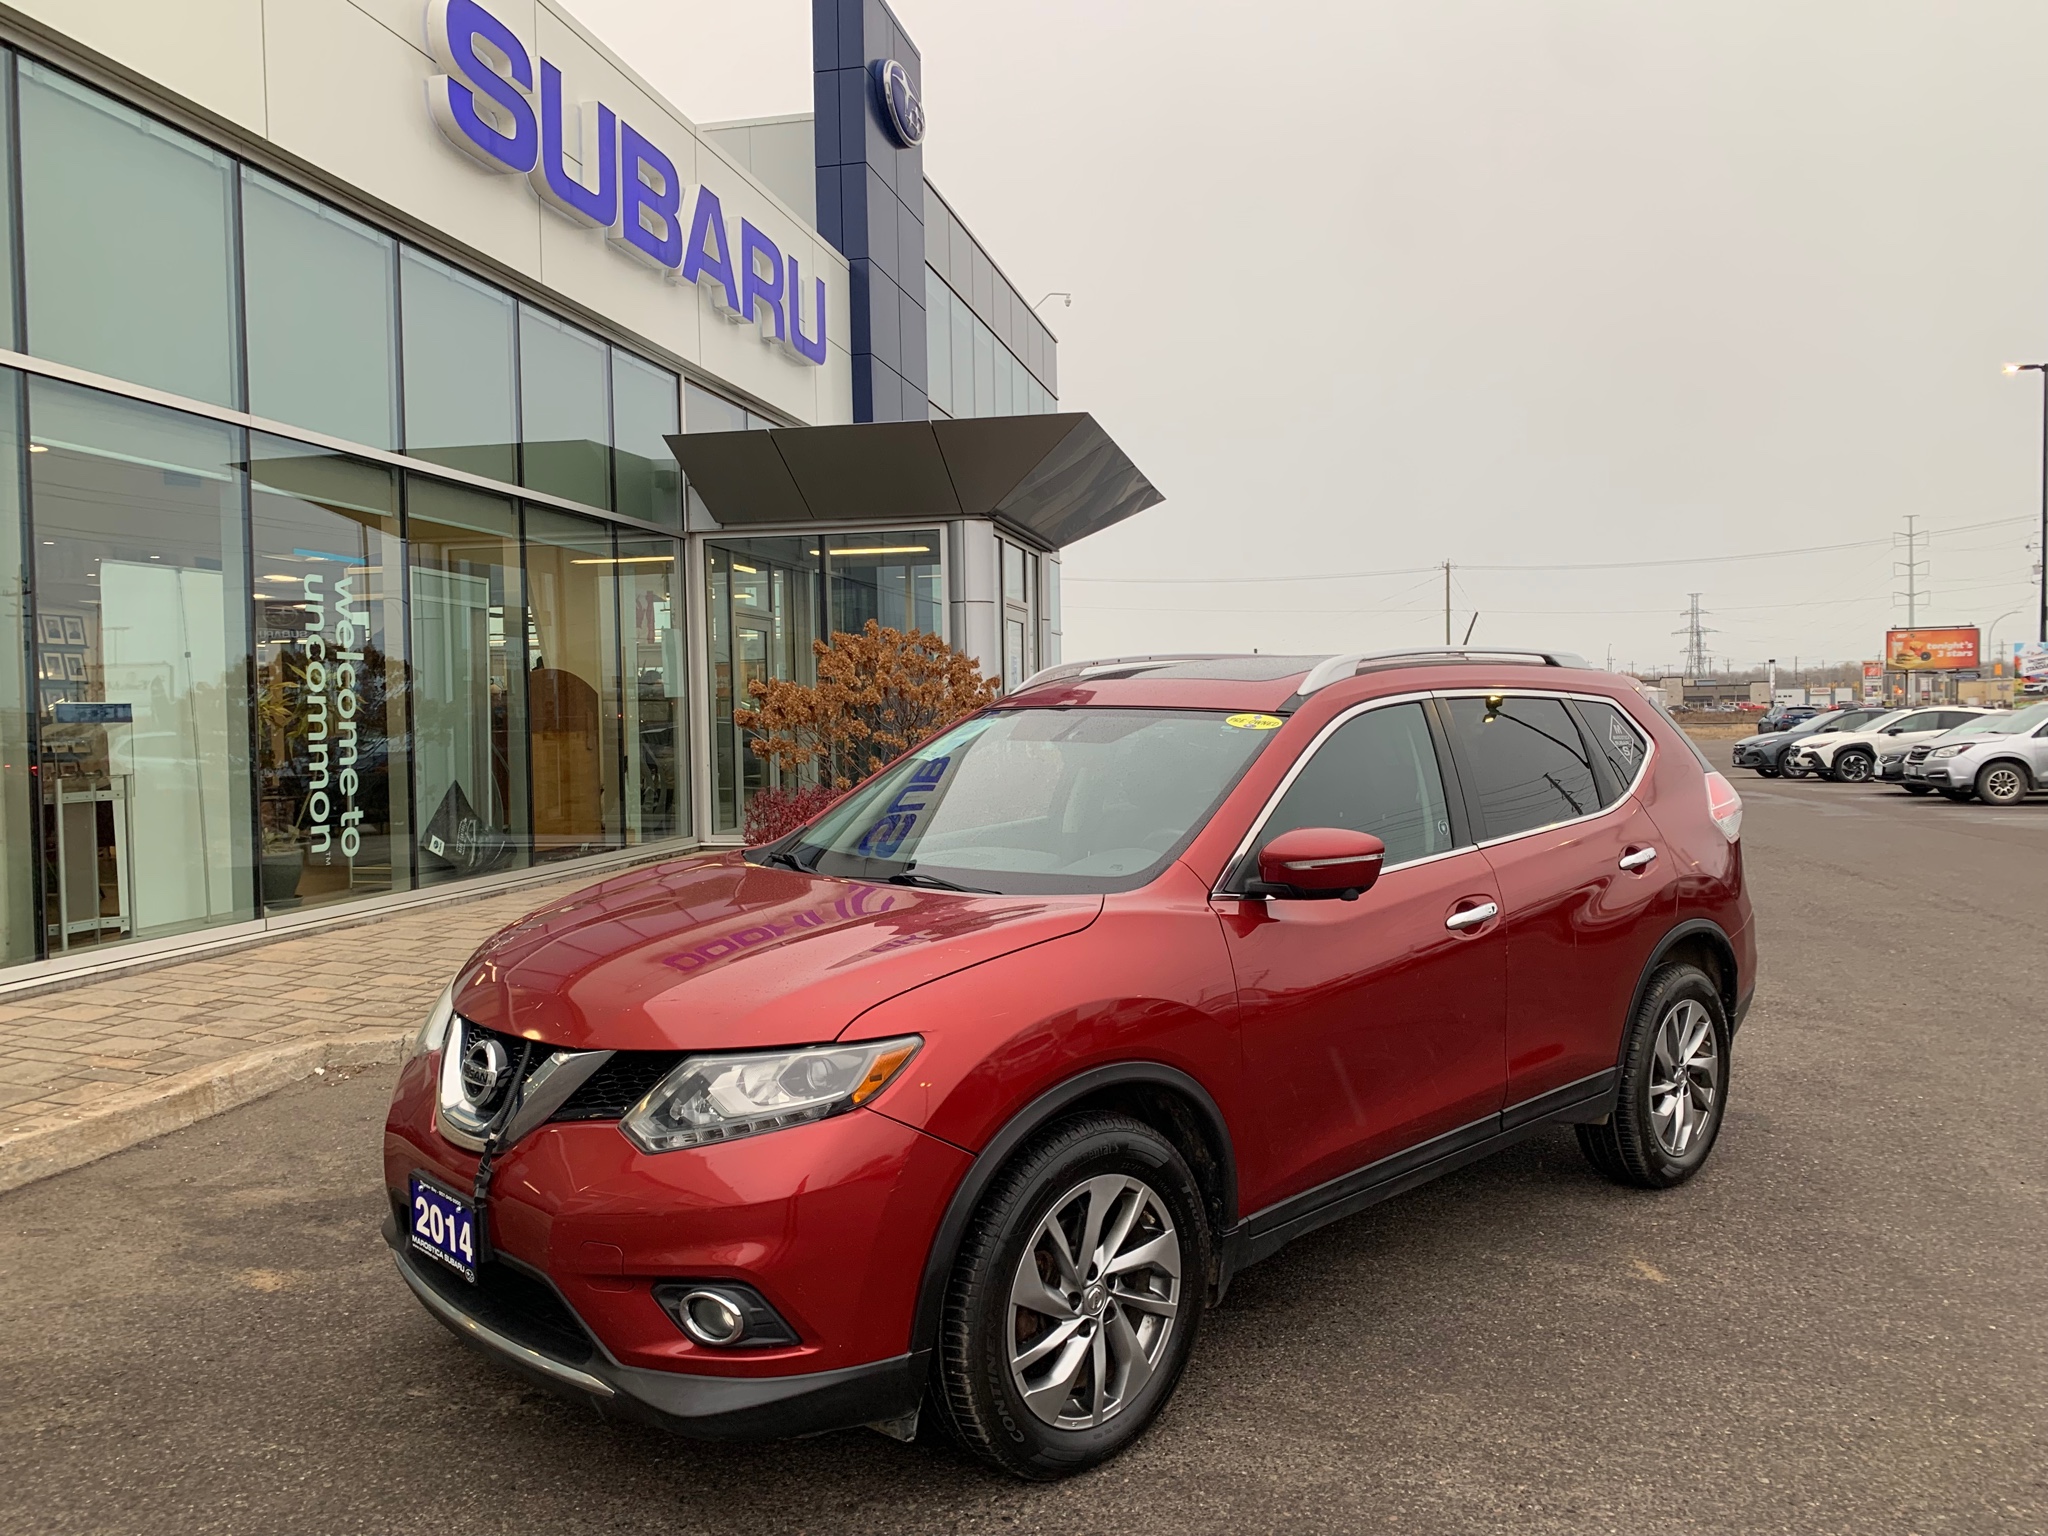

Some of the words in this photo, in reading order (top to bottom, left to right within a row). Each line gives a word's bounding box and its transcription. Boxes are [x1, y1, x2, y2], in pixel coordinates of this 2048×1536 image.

[441, 0, 826, 366] SUBARU
[1926, 641, 1974, 651] tonight's
[1946, 650, 1974, 658] stars
[303, 573, 331, 853] uncommon
[334, 576, 365, 796] welcome
[340, 806, 364, 858] to
[415, 1195, 474, 1263] 2014
[443, 1253, 466, 1274] SUBARU
